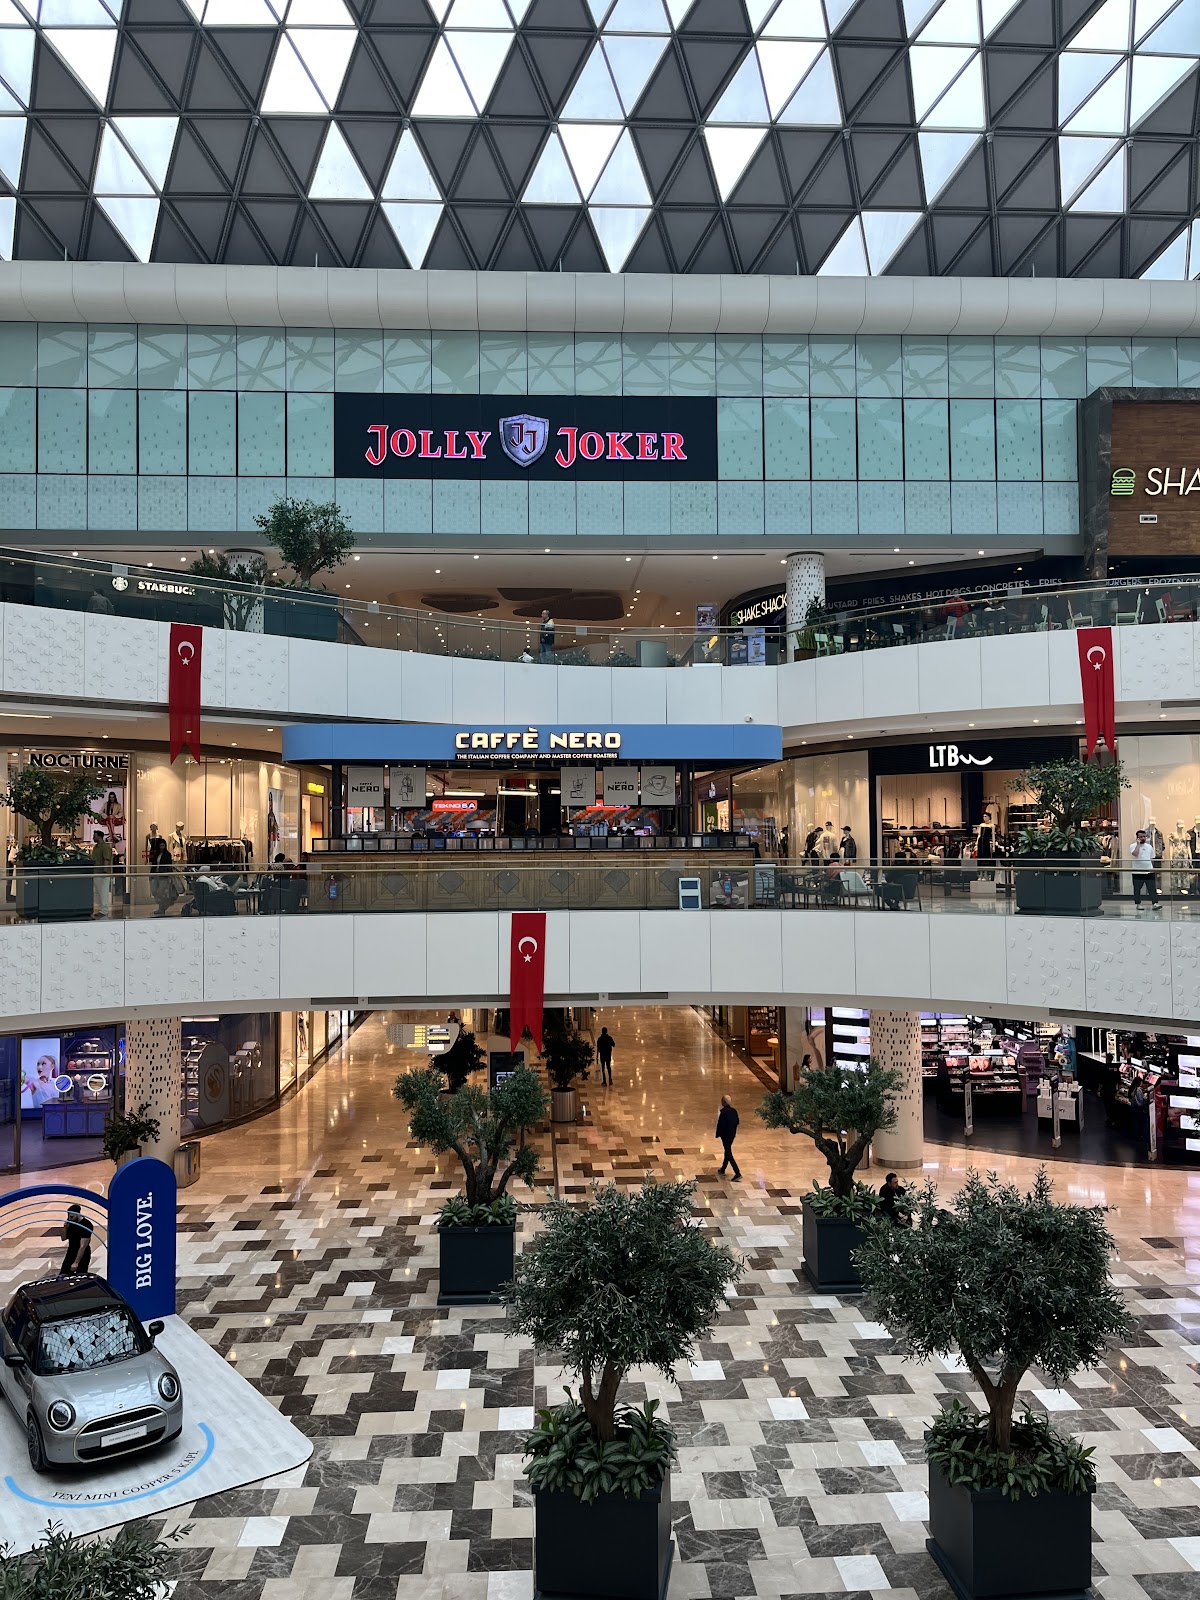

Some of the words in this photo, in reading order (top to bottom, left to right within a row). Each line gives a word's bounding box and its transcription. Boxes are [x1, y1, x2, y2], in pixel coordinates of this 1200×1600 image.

[364, 424, 492, 467] JOLLY
[554, 427, 688, 468] JOKER
[737, 603, 761, 625] SHAKE
[760, 593, 788, 616] SHACK
[862, 596, 885, 606] FRIES
[889, 592, 922, 603] SHAKES
[925, 589, 945, 599] HOT
[455, 726, 539, 749] CAFFÈ
[549, 732, 622, 749] NERO
[29, 753, 129, 769] NOCTURNE
[929, 744, 960, 767] LTB
[351, 785, 380, 793] NERO
[136, 1191, 152, 1252] LOVE.
[136, 1254, 152, 1289] BIG
[84, 1491, 118, 1501] MINI
[122, 1473, 174, 1496] COOPER
